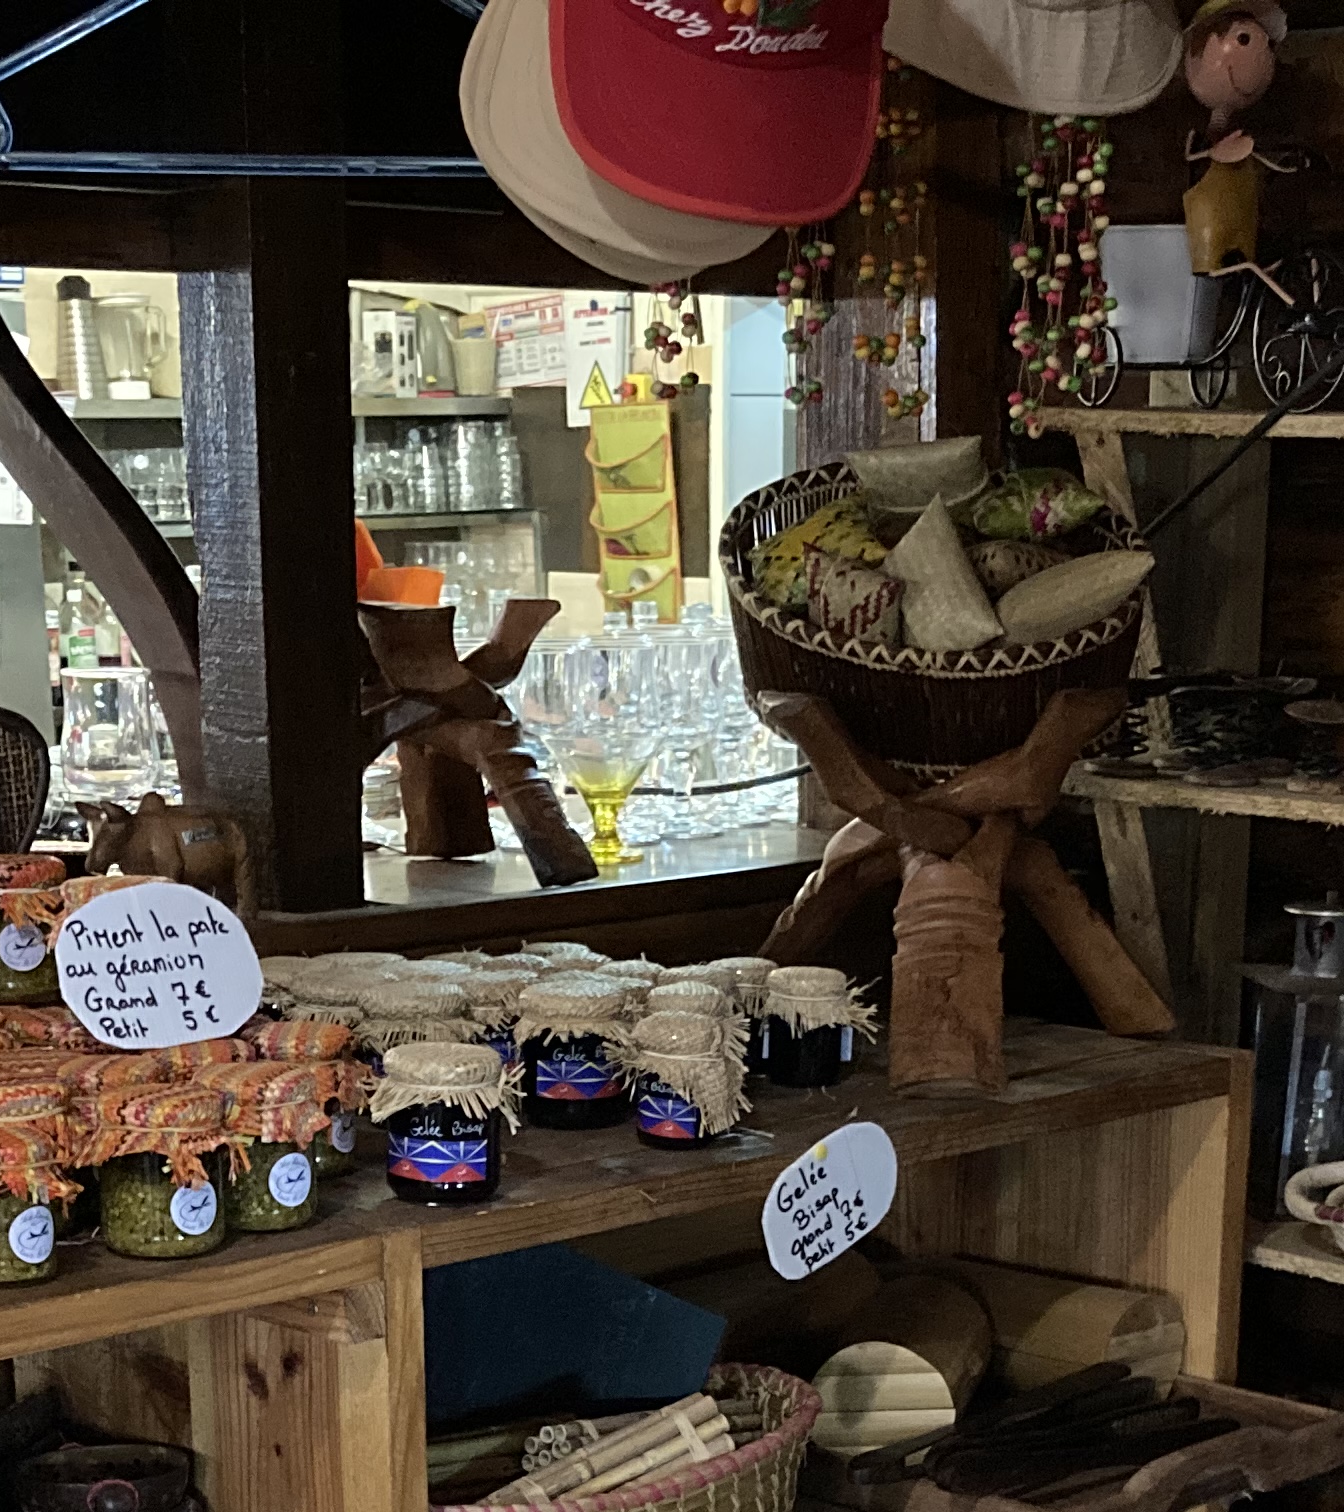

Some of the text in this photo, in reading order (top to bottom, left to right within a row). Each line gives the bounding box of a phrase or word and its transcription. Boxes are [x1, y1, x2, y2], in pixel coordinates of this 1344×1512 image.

[630, 0, 713, 38] hez
[149, 909, 179, 942] la
[66, 961, 98, 978] au
[99, 1017, 149, 1038] Petit
[776, 1162, 828, 1213] Gelée
[792, 1187, 840, 1231] Bisap
[790, 1213, 833, 1260] grand
[805, 1238, 835, 1273] petit
